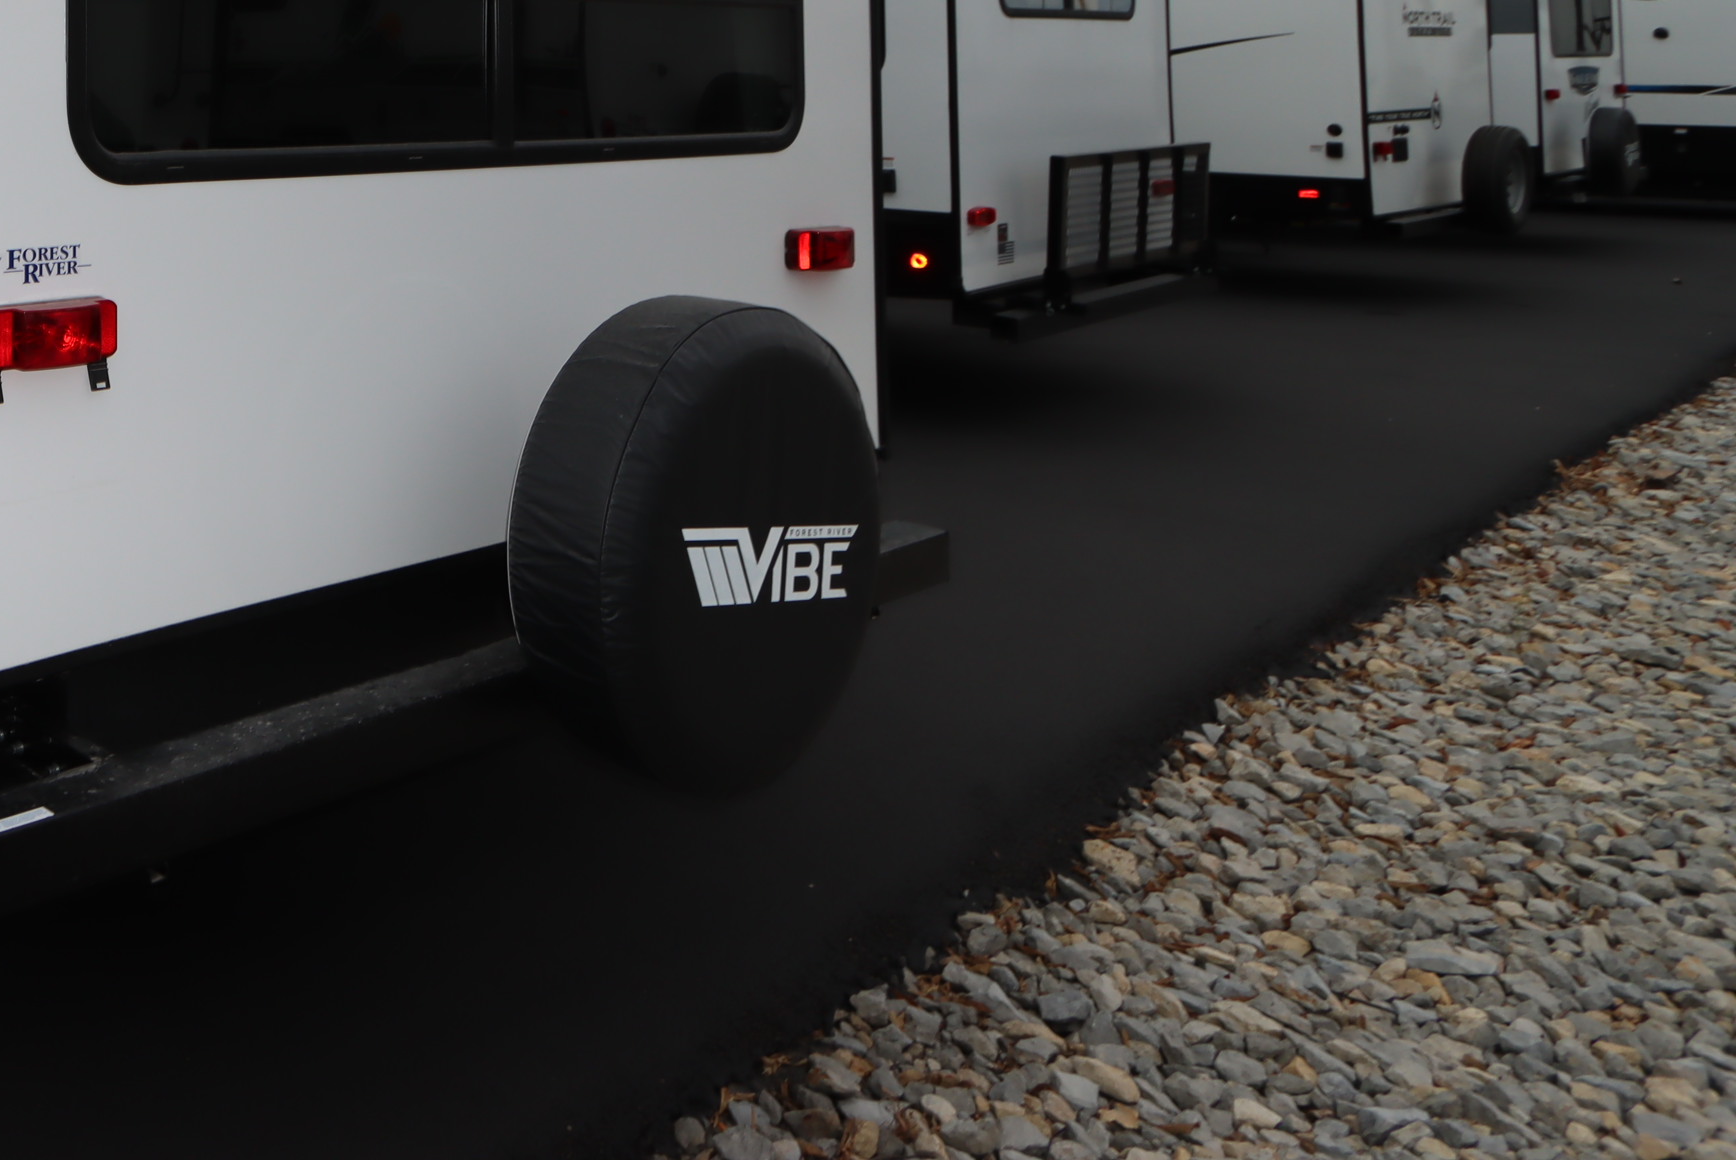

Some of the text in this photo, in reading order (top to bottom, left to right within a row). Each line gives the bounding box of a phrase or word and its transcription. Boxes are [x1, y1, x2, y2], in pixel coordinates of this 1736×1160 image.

[6, 243, 81, 270] FOREST
[22, 260, 79, 285] RIVER
[789, 526, 854, 537] FOREST RIVER
[728, 526, 851, 604] VIBE
